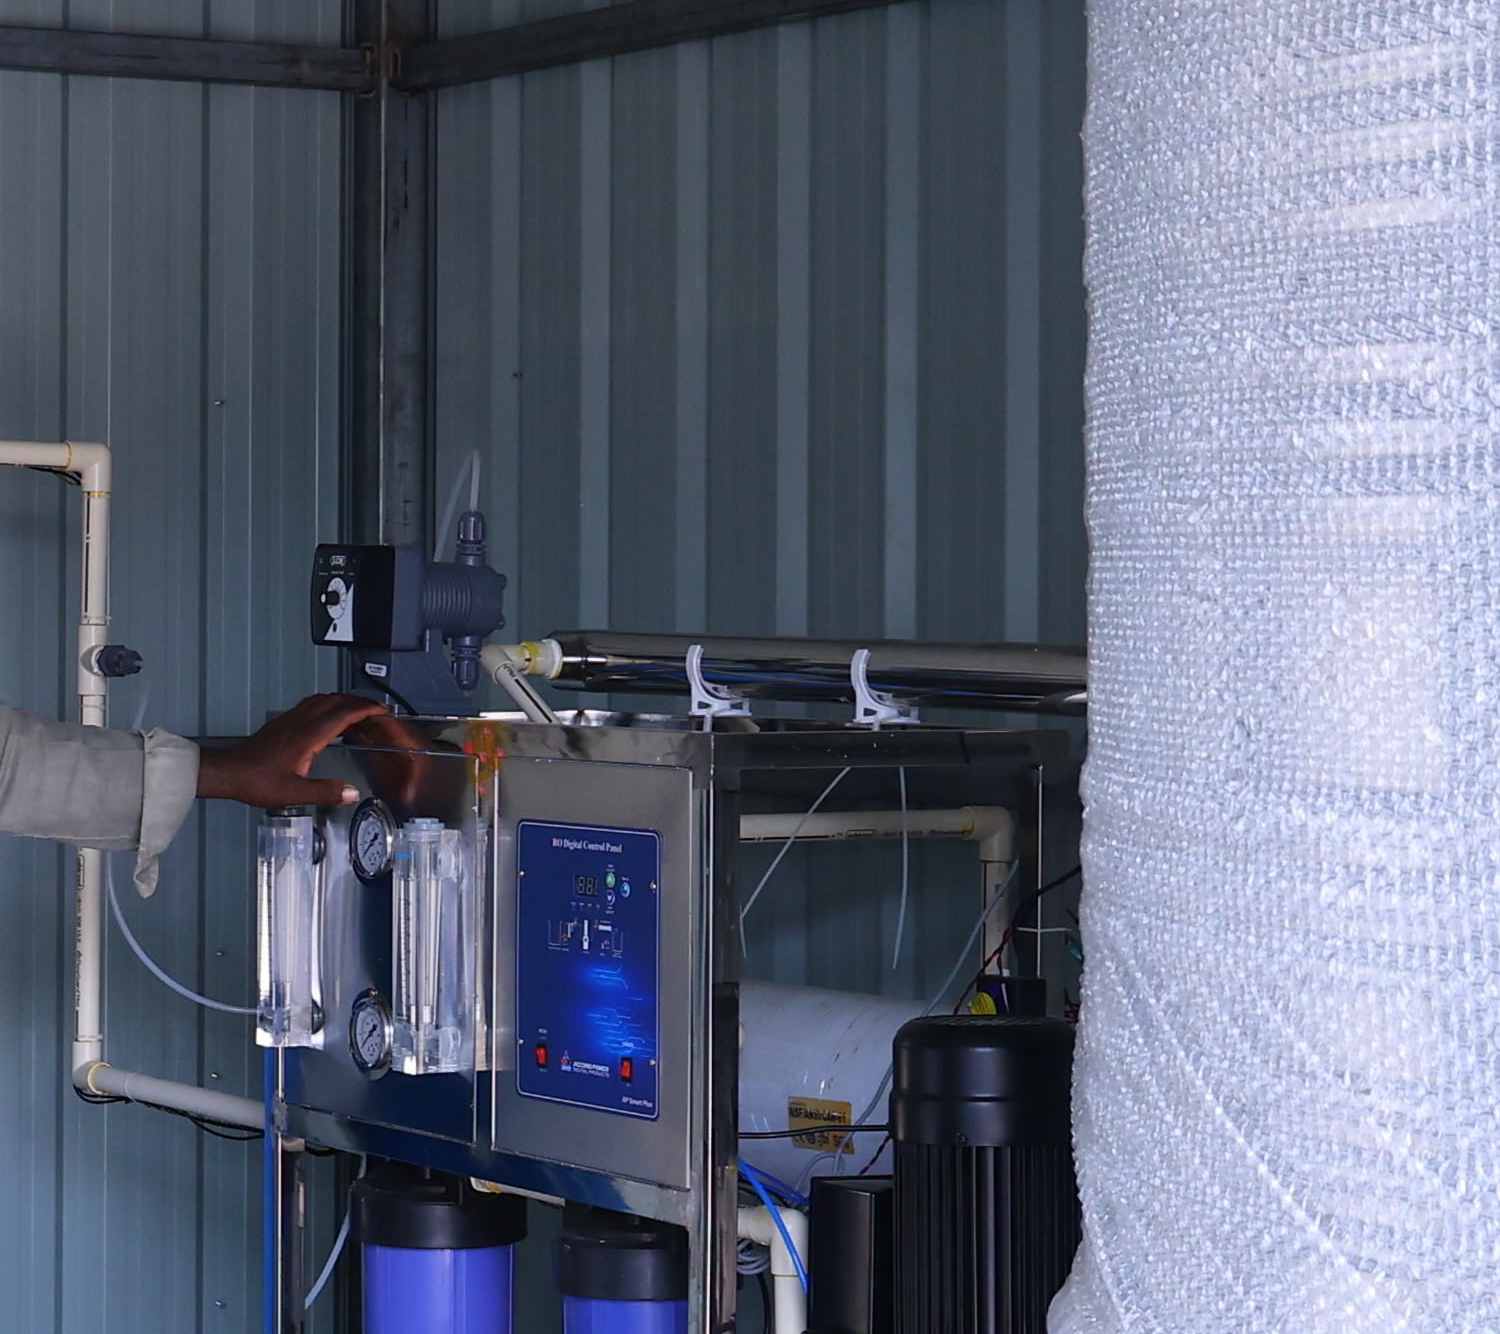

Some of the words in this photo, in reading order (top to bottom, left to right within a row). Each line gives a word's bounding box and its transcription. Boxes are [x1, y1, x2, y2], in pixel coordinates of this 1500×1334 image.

[552, 837, 562, 847] RO
[563, 839, 583, 851] Digital
[583, 841, 605, 852] Control
[605, 842, 622, 853] Panel
[588, 1070, 610, 1078] PRODUCTS
[642, 1099, 653, 1108] Plus
